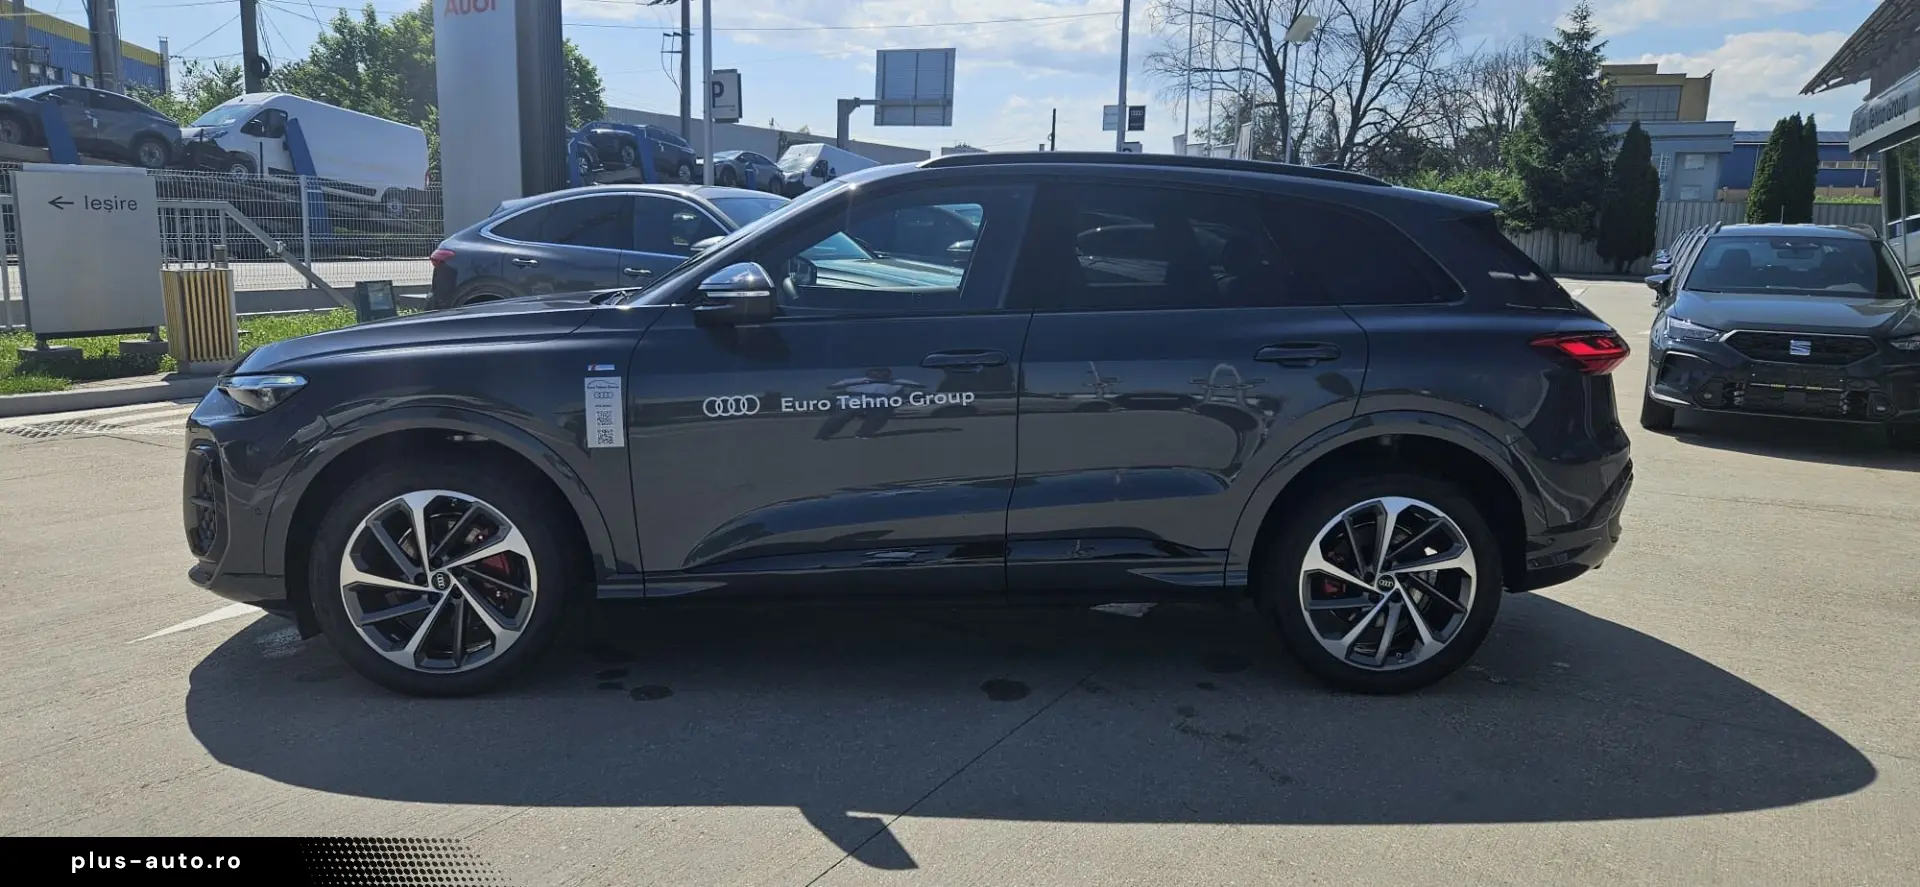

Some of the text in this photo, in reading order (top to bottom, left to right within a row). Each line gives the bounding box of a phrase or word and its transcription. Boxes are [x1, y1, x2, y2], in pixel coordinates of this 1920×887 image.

[712, 81, 724, 108] P
[84, 195, 138, 213] Ieșire
[781, 391, 975, 412] Euro Tehno Group
